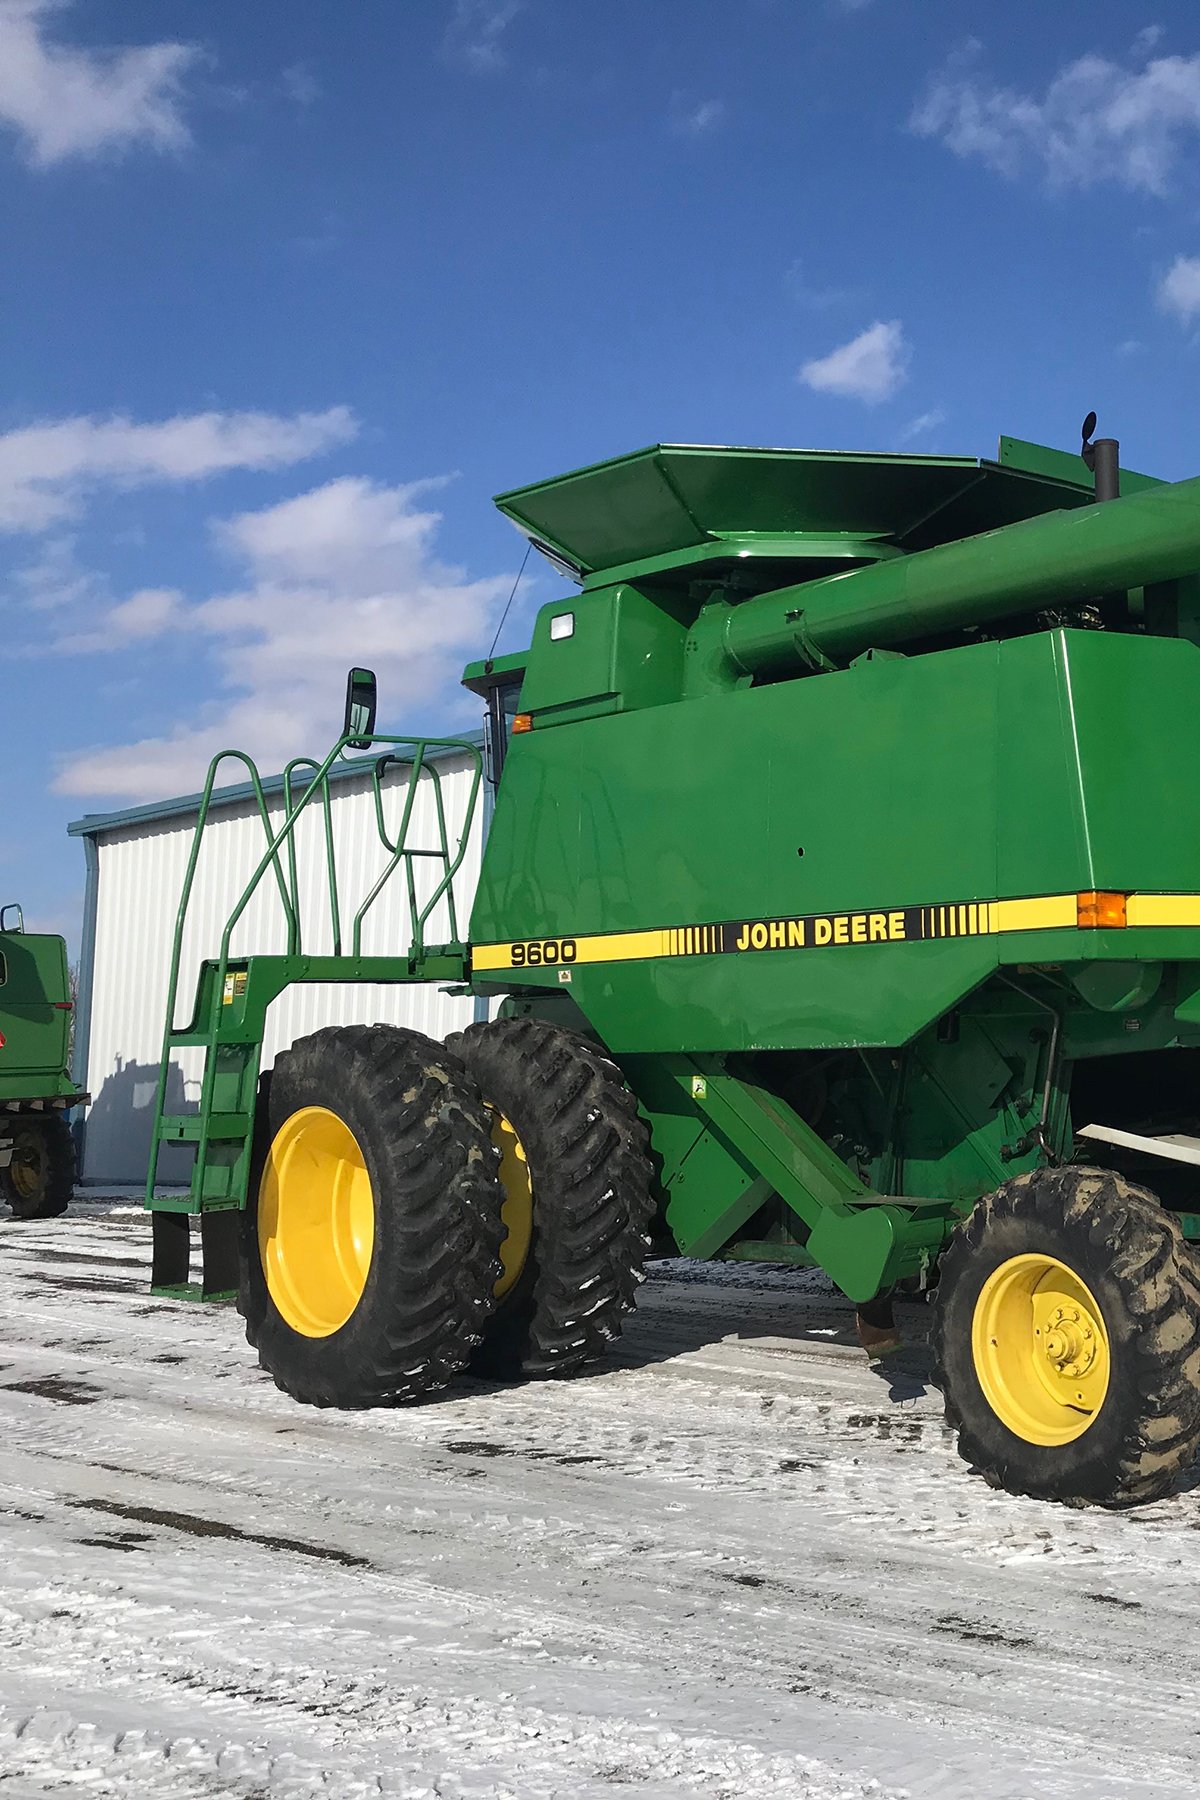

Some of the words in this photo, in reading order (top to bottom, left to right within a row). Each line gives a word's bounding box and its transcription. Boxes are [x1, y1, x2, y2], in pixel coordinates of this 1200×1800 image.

[736, 920, 805, 951] JOHN
[814, 911, 906, 945] DEERE
[511, 939, 577, 966] 9600
